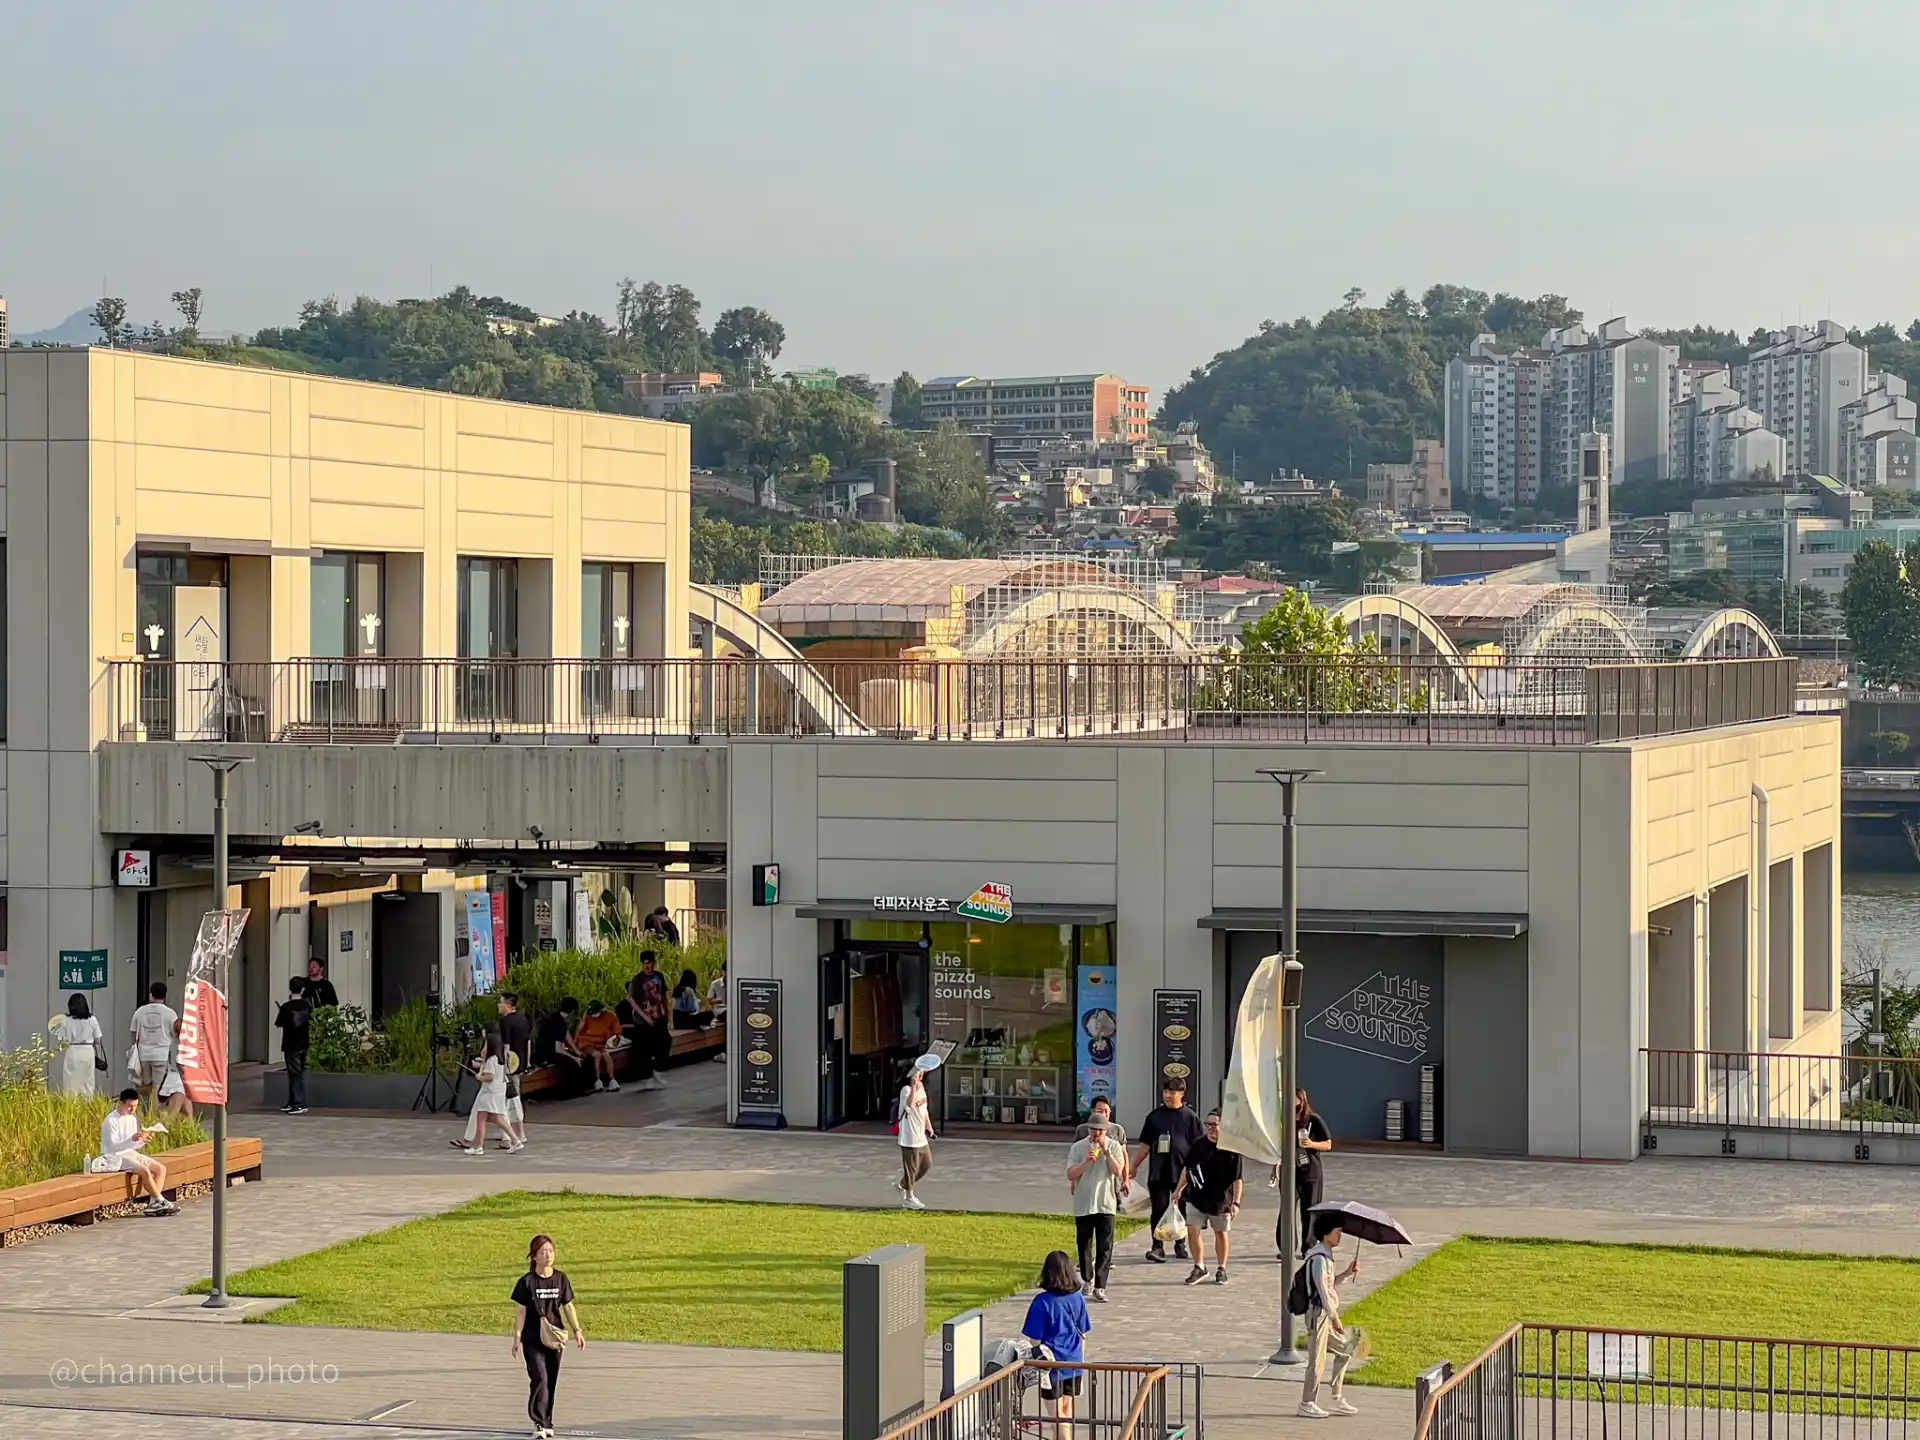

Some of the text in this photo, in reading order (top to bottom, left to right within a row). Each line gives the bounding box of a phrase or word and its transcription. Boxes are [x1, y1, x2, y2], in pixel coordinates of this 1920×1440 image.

[1894, 468, 1907, 476] 104
[873, 895, 951, 912] 더피자사운즈
[978, 891, 1012, 906] PIZZA
[966, 900, 1013, 917] SOUNDS
[934, 951, 962, 967] the
[934, 969, 976, 986] pizza
[934, 985, 992, 999] sounds
[1380, 974, 1430, 1004] THE
[1353, 989, 1430, 1026] PIZZA
[1325, 1007, 1428, 1052] SOUNDS
